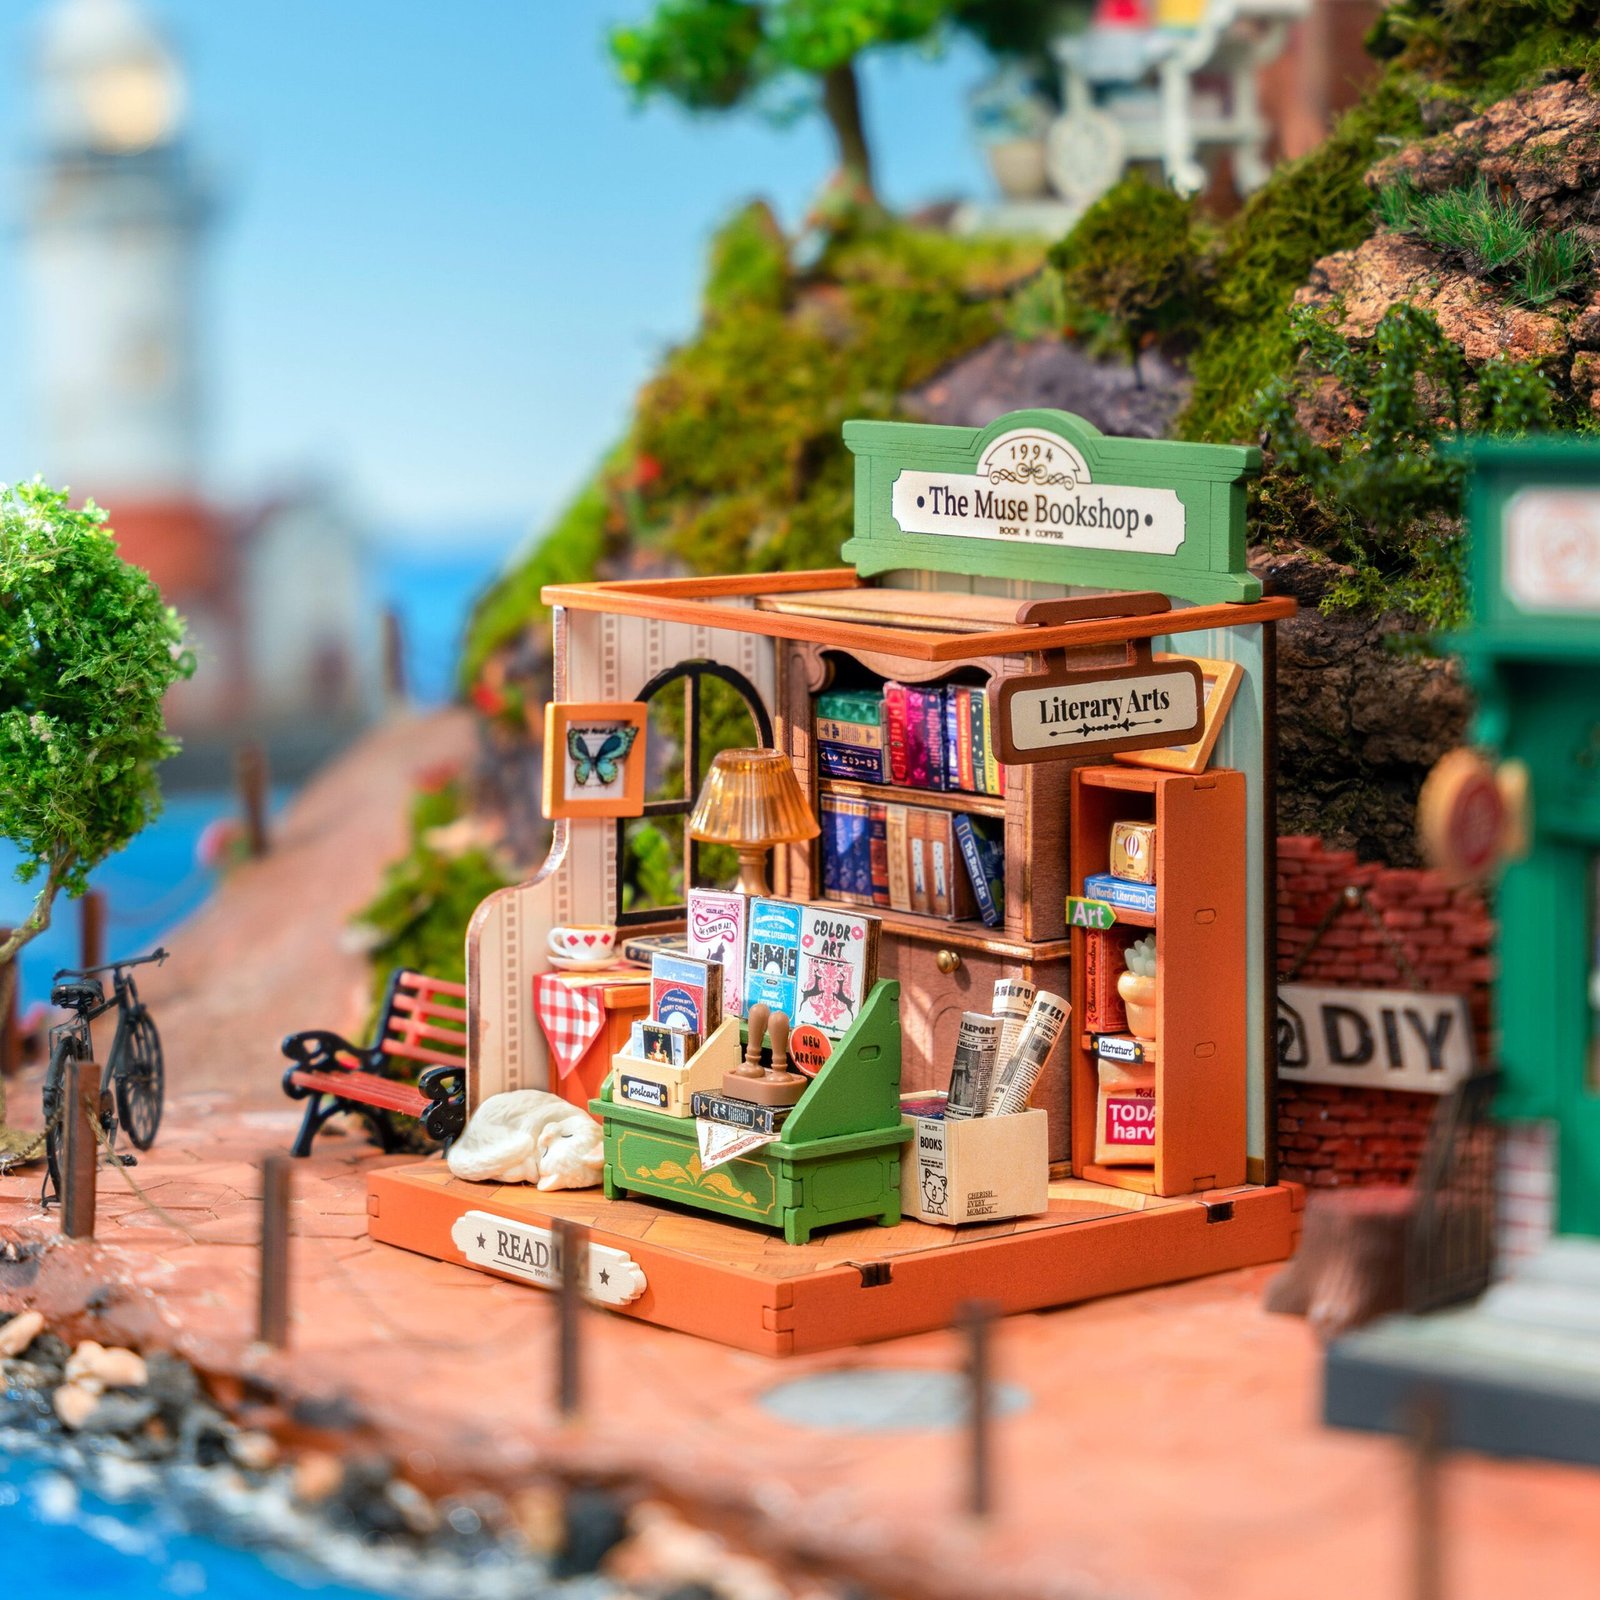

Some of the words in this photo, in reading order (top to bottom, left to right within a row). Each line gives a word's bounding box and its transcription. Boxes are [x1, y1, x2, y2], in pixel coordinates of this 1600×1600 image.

[1010, 444, 1052, 462] 1994
[929, 486, 969, 517] The
[974, 490, 1029, 521] Muse
[1034, 494, 1139, 538] Bookshop
[999, 527, 1020, 535] BOOK
[1035, 530, 1064, 539] COFFEE
[1039, 696, 1123, 724] Literary
[1126, 687, 1170, 714] Arts
[1073, 902, 1104, 927] Art
[814, 919, 850, 941] COLOR
[821, 939, 845, 958] ART
[964, 1022, 996, 1035] REPORT
[802, 1035, 820, 1048] NEW
[1320, 1004, 1453, 1073] DIY
[630, 1085, 659, 1101] postcard
[1113, 1122, 1155, 1140] harv
[920, 1136, 942, 1151] BOOKS
[967, 1199, 985, 1208] EVERY
[968, 1191, 993, 1199] CHERISH
[967, 1206, 993, 1216] MOMENT
[497, 1230, 561, 1272] READI
